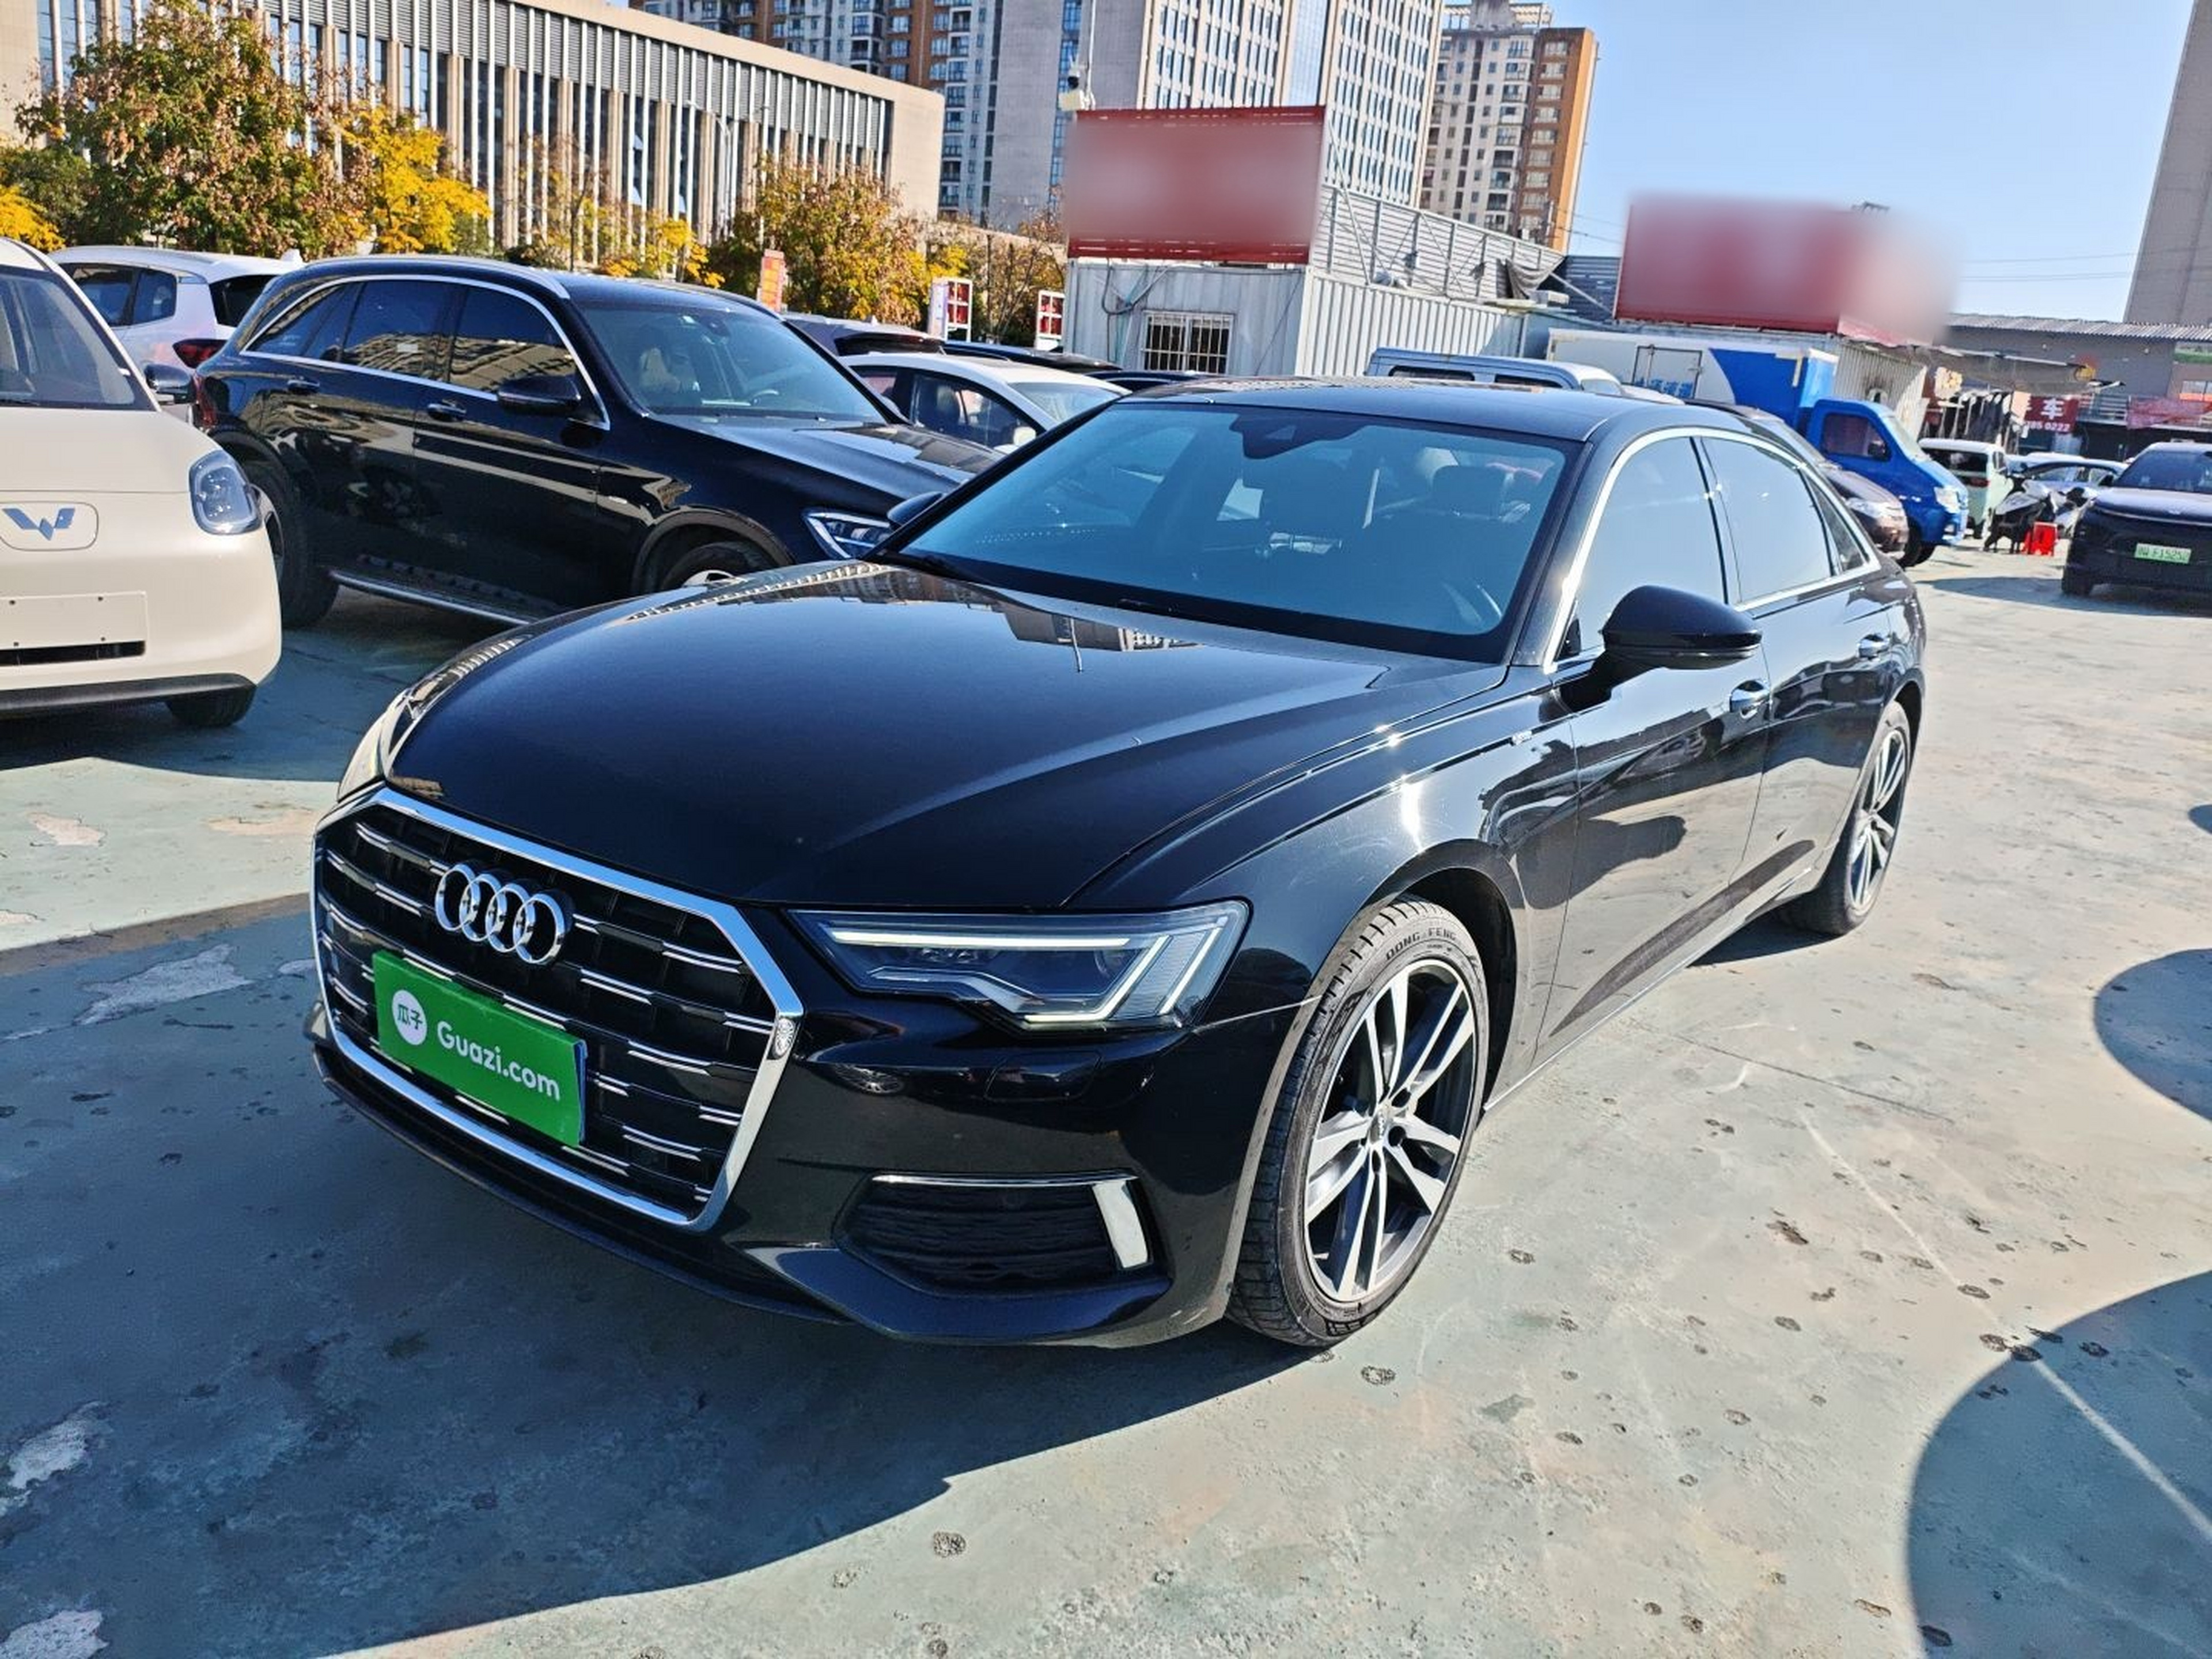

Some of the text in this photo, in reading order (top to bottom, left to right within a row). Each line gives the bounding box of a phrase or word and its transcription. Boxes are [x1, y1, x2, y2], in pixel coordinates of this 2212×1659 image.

[1385, 927, 1457, 961] DONG FENG
[397, 1003, 423, 1031] 瓜子
[437, 1021, 560, 1101] Guazi.com
